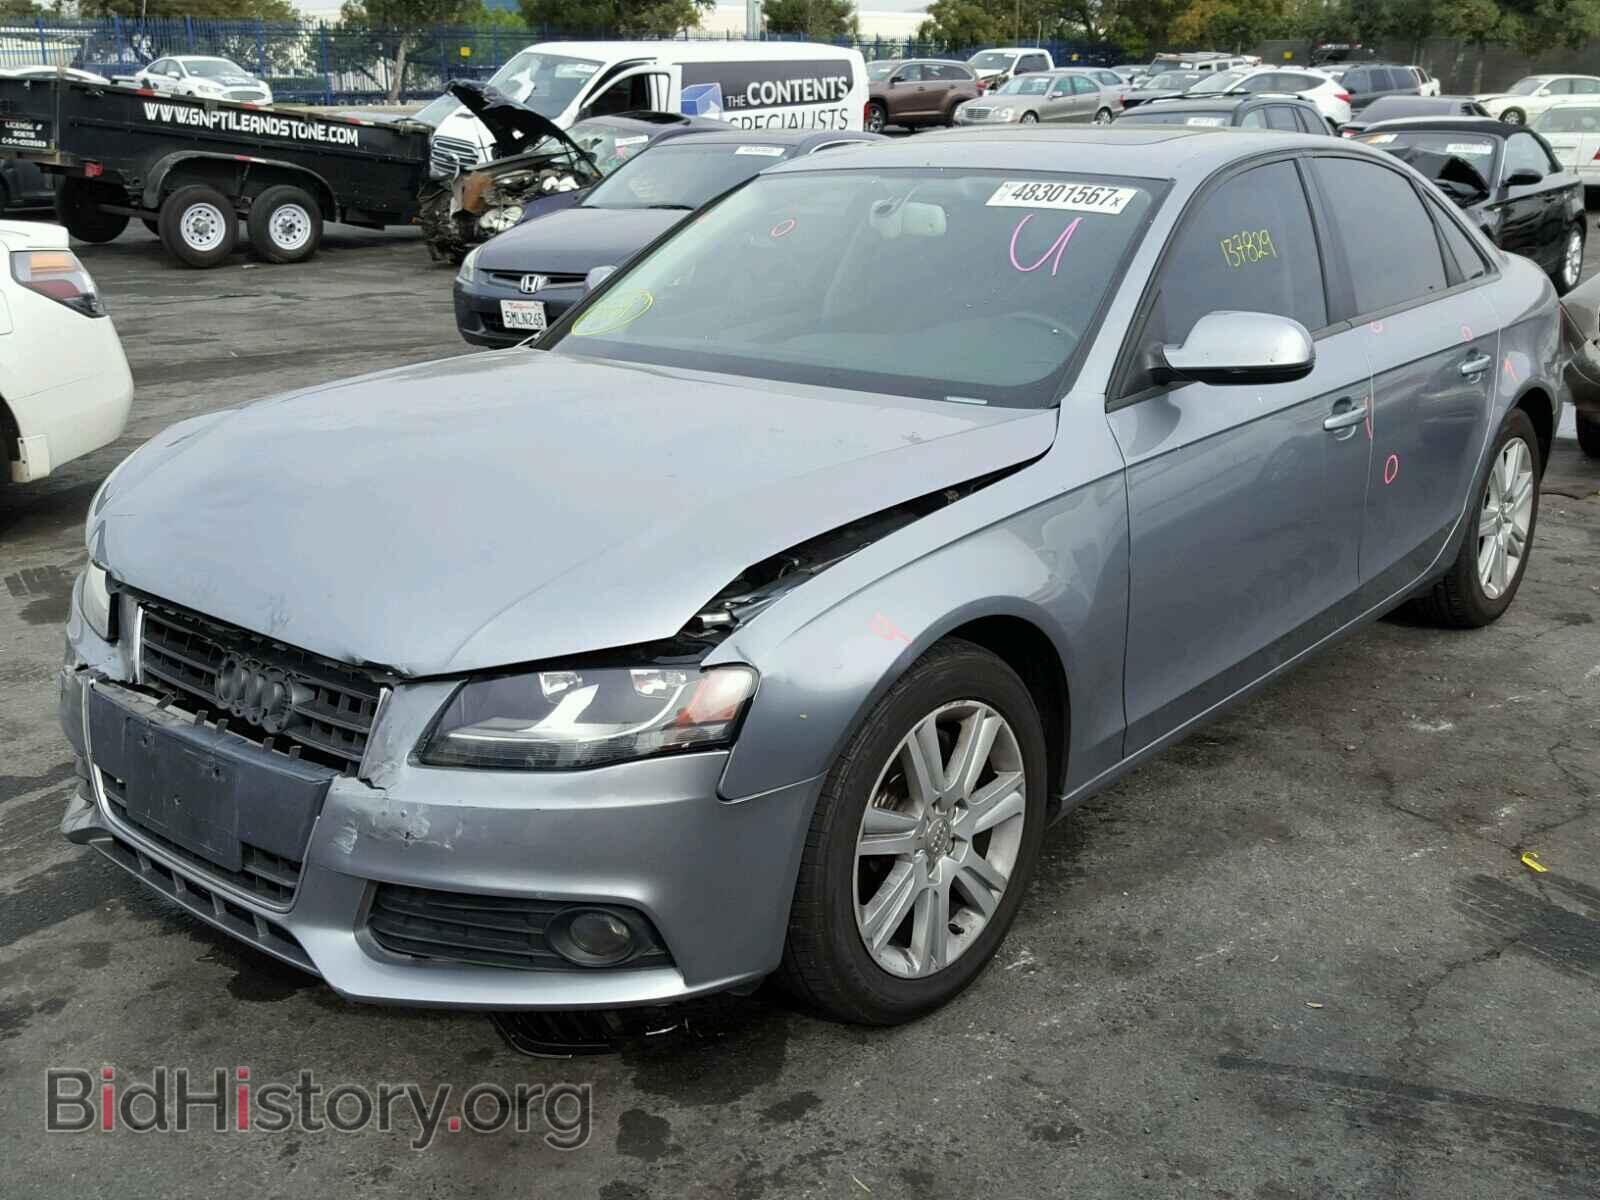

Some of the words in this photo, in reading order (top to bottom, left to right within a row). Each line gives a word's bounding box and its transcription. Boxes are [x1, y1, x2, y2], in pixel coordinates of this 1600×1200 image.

[726, 95, 746, 107] THE
[747, 76, 848, 106] CONTENTS
[144, 102, 359, 147] WWW.GNPTILEANDSTONE.COM
[505, 311, 544, 326] 5MLN265
